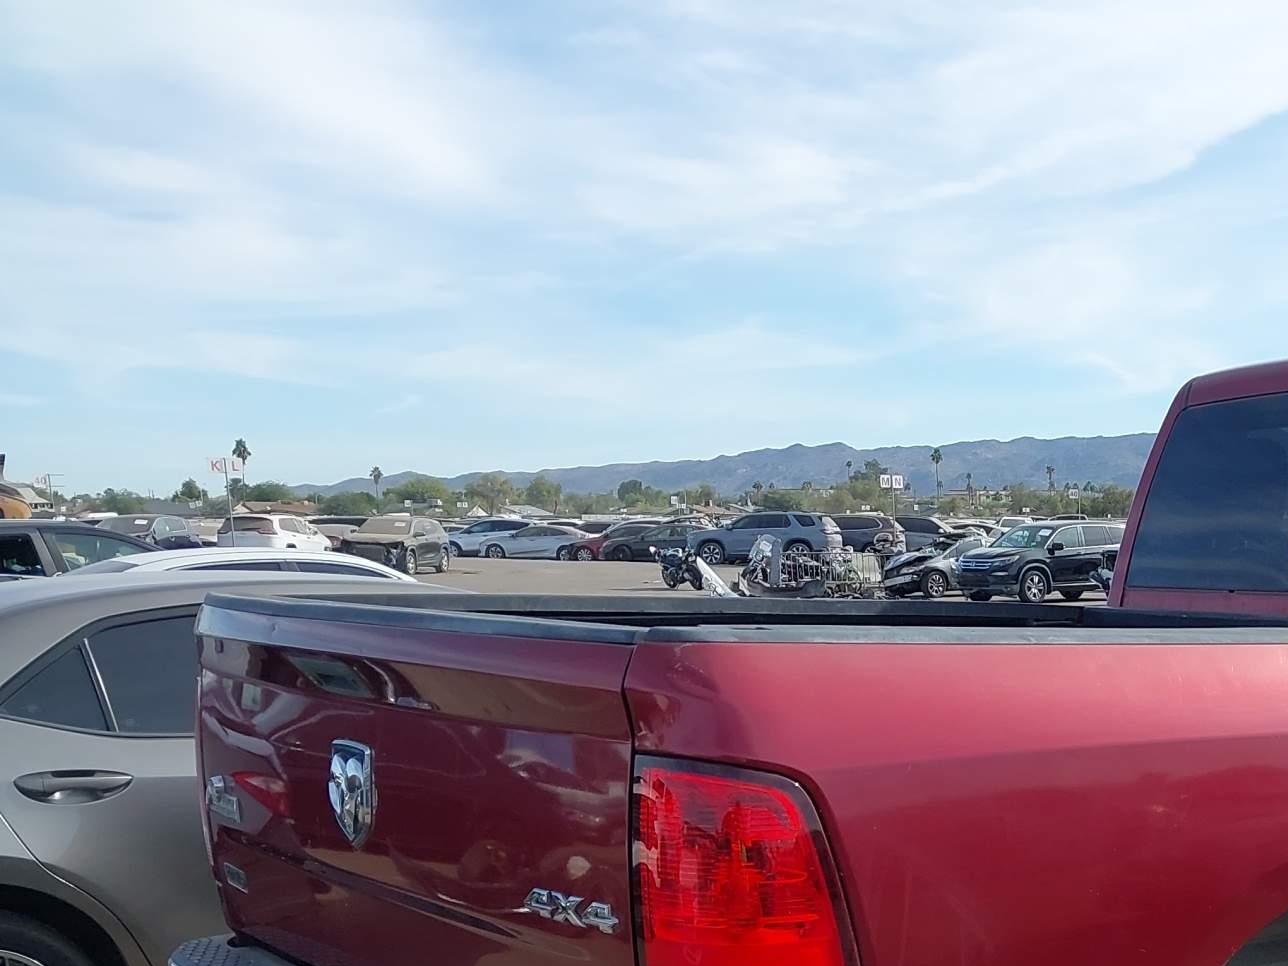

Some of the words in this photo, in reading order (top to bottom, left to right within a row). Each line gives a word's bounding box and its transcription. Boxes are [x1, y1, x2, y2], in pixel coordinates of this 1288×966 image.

[211, 460, 220, 471] K
[232, 461, 240, 471] L
[881, 477, 890, 486] M
[894, 477, 902, 487] N
